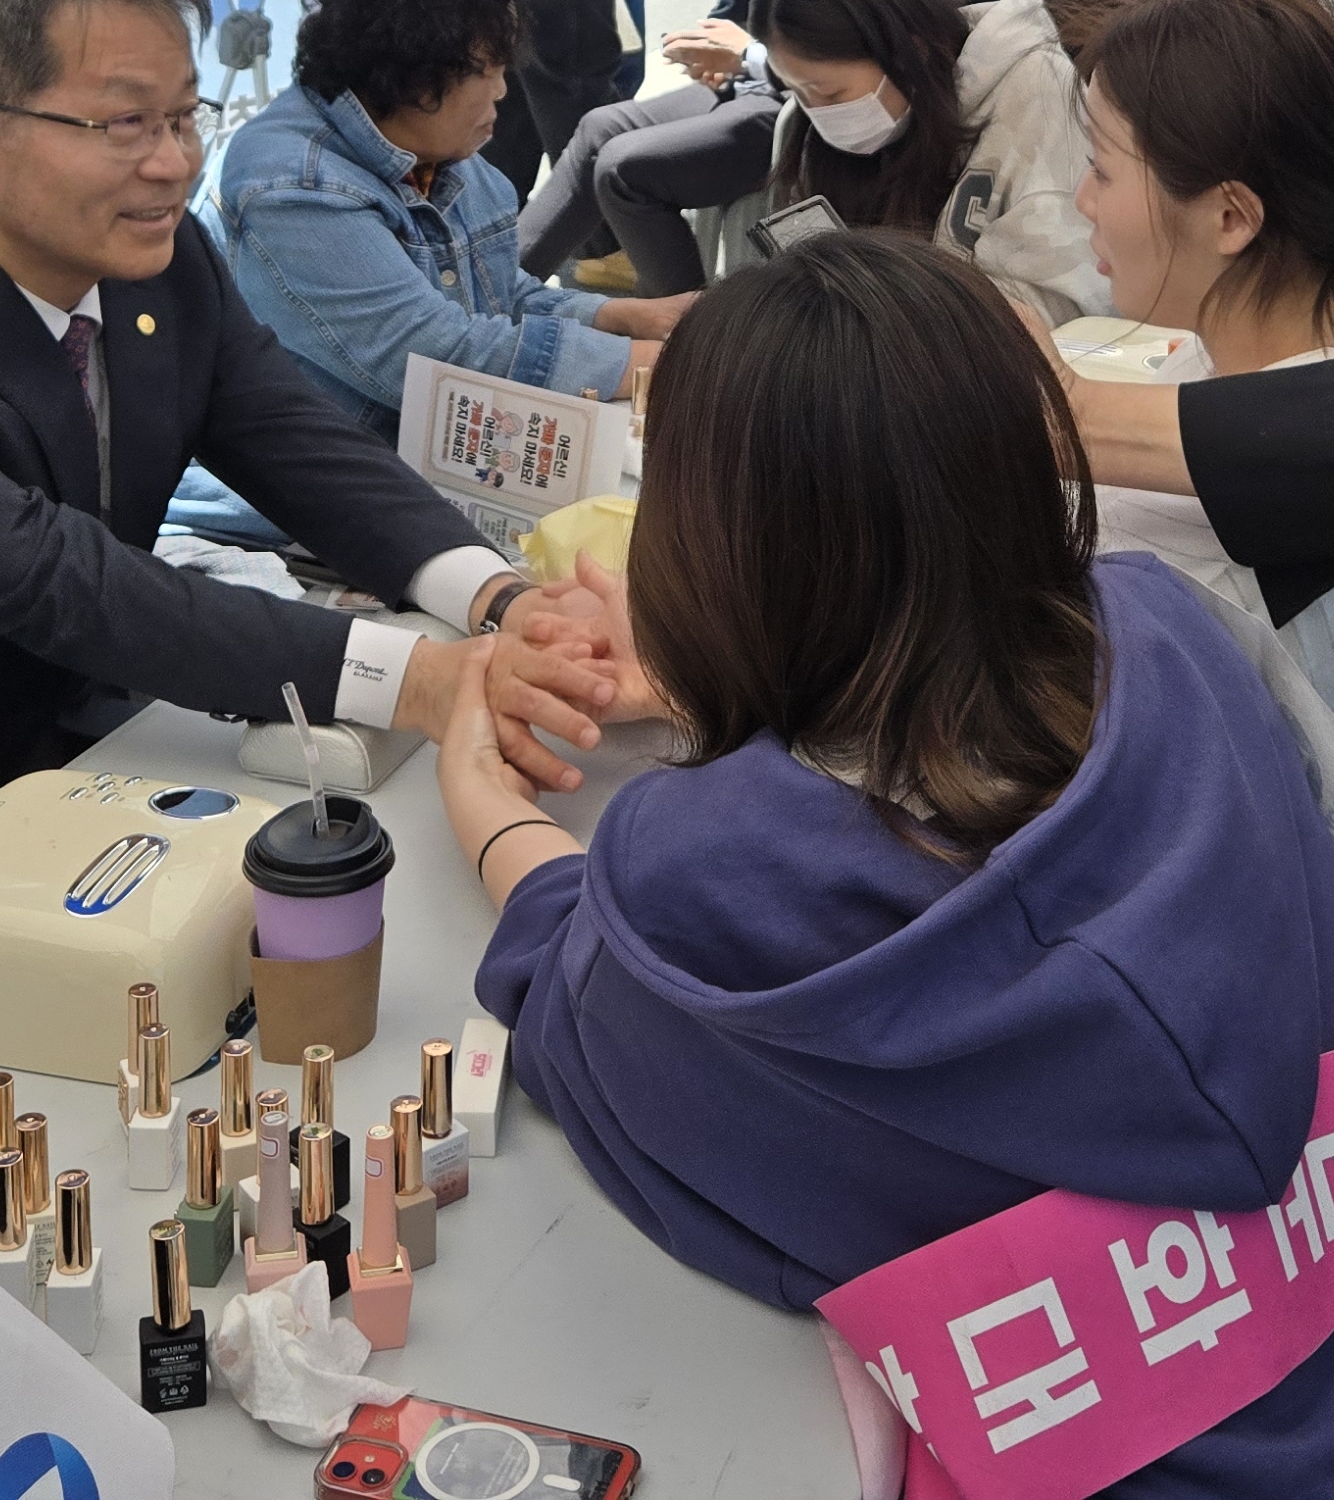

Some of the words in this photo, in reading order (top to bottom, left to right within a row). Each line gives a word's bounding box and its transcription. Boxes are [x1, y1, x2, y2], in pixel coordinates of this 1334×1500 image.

[450, 422, 466, 464] 마세요!
[527, 412, 542, 439] 속지
[520, 441, 537, 486] 마세요!
[554, 434, 571, 479] 어르신!
